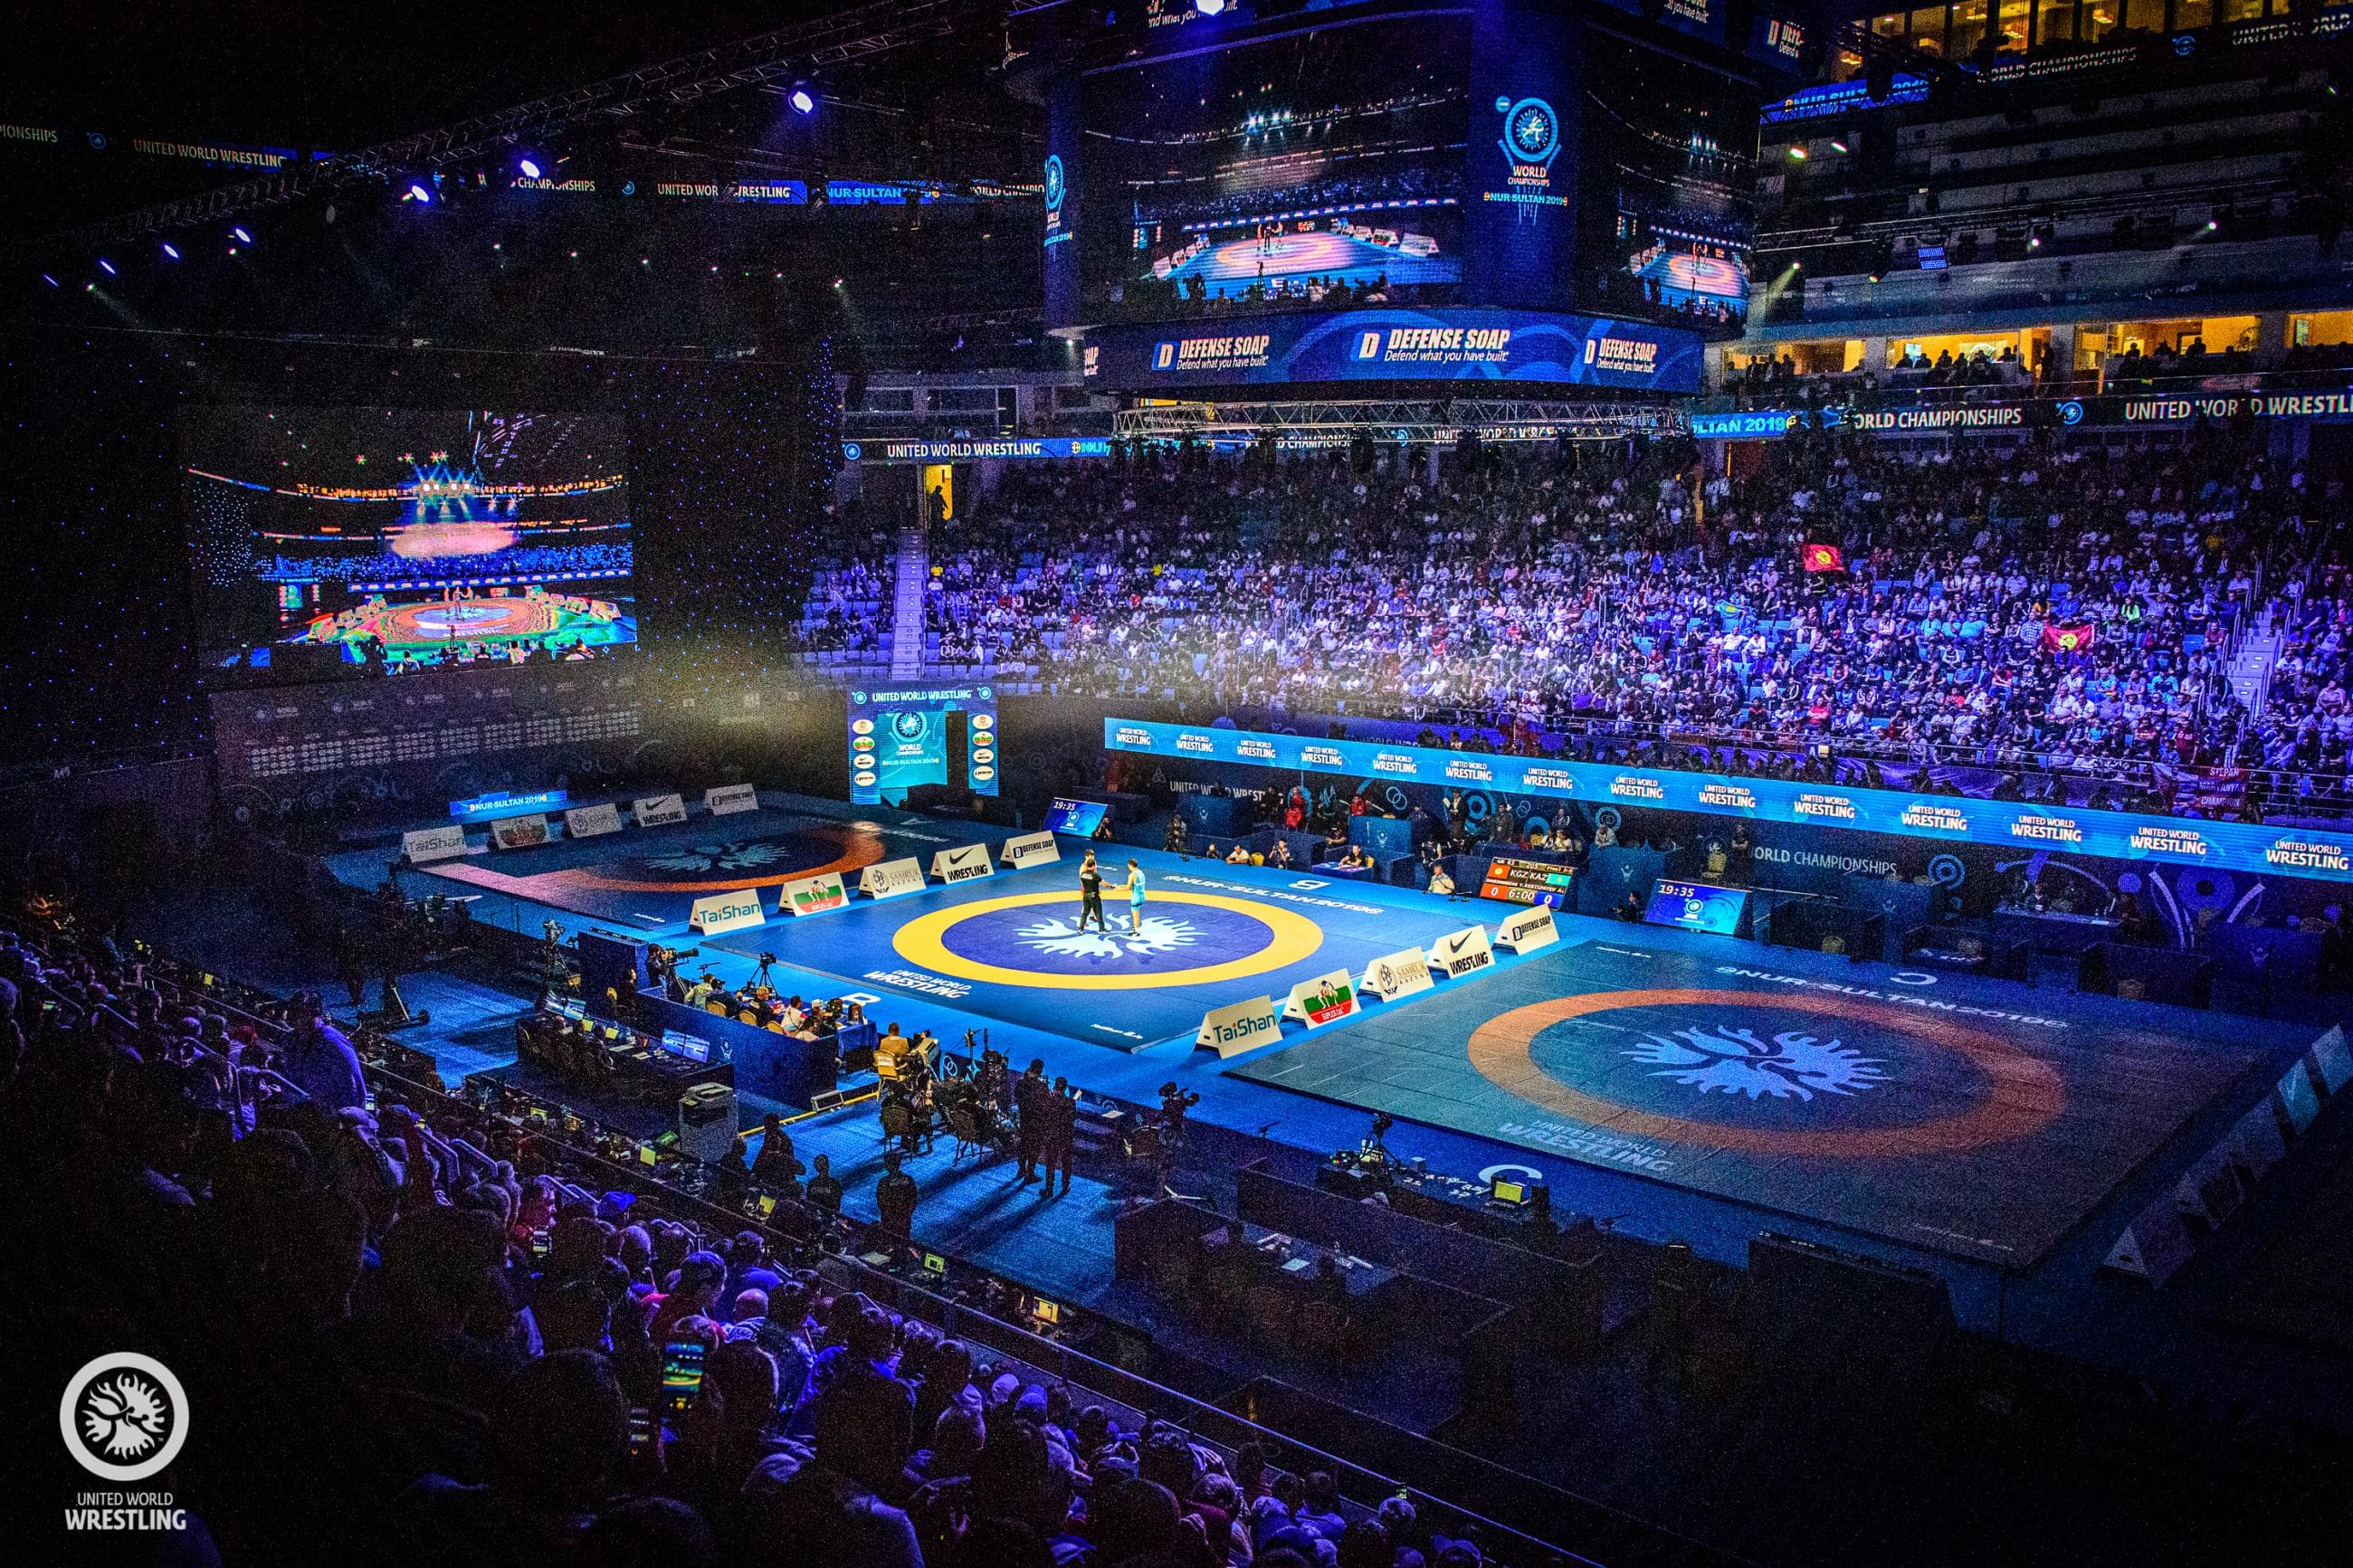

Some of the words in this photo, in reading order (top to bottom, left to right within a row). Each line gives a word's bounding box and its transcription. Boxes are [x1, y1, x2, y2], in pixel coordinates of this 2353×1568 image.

[134, 138, 176, 156] UNITED
[178, 145, 218, 160] WORLD
[1512, 166, 1547, 178] WORLD
[1508, 176, 1550, 187] CHAMPIONSHIPS
[658, 183, 693, 196] UNITED
[695, 184, 719, 197] WOR
[1546, 195, 1564, 206] 2019
[1179, 338, 1234, 359] DEFENSE
[1234, 335, 1270, 356] SOAP
[1359, 333, 1381, 359] D
[1387, 328, 1464, 350] DEFENSE
[1464, 329, 1510, 350] SOAP
[1158, 344, 1174, 368] D
[1385, 350, 1419, 362] Defend
[1419, 350, 1443, 362] what
[1443, 351, 1462, 365] you
[1462, 350, 1484, 362] have
[1585, 339, 1596, 365] D
[1599, 337, 1634, 360] DEFENSE
[1634, 342, 1657, 363] SOAP
[1177, 357, 1201, 371] Defend
[1201, 357, 1218, 369] what
[1217, 358, 1232, 372] you
[1232, 356, 1249, 368] have
[1854, 413, 1894, 429] ORLD
[1898, 407, 2023, 429] CHAMPIONSHIPS
[2126, 401, 2191, 421] UNITED
[1744, 418, 1786, 432] 2019
[888, 443, 929, 458] UNITED
[931, 443, 972, 458] WORLD
[974, 442, 1042, 457] WRESTLING
[872, 691, 899, 703] UNITED
[900, 691, 928, 701] WORLD
[928, 689, 973, 700] WRESTLING
[899, 744, 921, 752] WORLD
[1116, 734, 1151, 746] WRESTLING
[1176, 740, 1214, 753] WRESTLING
[1241, 739, 1254, 747] UNITED
[1254, 740, 1272, 749] WORLD
[1237, 746, 1275, 759] WRESTLING
[1301, 753, 1343, 765] WRESTLING
[1321, 747, 1338, 755] WORLD
[1377, 753, 1394, 761] UNITED
[1395, 755, 1412, 763] WORLD
[1373, 760, 1416, 774] WRESTLING
[1450, 760, 1468, 768] UNITED
[1469, 762, 1487, 770] WORLD
[1528, 767, 1547, 776] UNITED
[1548, 769, 1567, 778] WORLD
[2210, 767, 2240, 777] STEPAN
[1445, 766, 1491, 782] WRESTLING
[1523, 774, 1573, 789] WRESTLING
[1615, 776, 1635, 785] UNITED
[1637, 778, 1658, 787] WORLD
[1610, 783, 1663, 799] WRESTLING
[1705, 784, 1726, 794] UNITED
[1727, 786, 1749, 796] WORLD
[476, 796, 524, 811] NUR-SULTAN
[524, 794, 543, 805] 2019
[1053, 802, 1076, 812] 19:35
[1699, 792, 1756, 808] WRESTLING
[1800, 794, 1824, 804] UNITED
[1825, 795, 1849, 805] WORLD
[1794, 802, 1854, 819] WRESTLING
[1909, 805, 1934, 815] UNITED
[1935, 807, 1960, 817] WORLD
[1901, 813, 1967, 831] WRESTLING
[2019, 815, 2046, 827] UNITED
[2047, 818, 2075, 829] WORLD
[2012, 824, 2082, 842] WRESTLING
[2139, 827, 2167, 839] UNITED
[2169, 830, 2199, 841] WORLD
[1023, 841, 1042, 852] DEFENSE
[1042, 840, 1054, 848] SOAP
[2130, 836, 2206, 855] WRESTLING
[2275, 841, 2307, 851] UNITED
[2309, 844, 2341, 855] WORLD
[1755, 846, 1791, 863] ORLD
[1795, 851, 1898, 876] CHAMPIONSHIPS
[2265, 850, 2349, 870] WRESTLING
[890, 866, 921, 880] SAMRUK
[948, 864, 988, 881] WRESTLING
[1510, 870, 1529, 878] KGZ
[1529, 871, 1548, 881] KAZ
[1175, 877, 1315, 905] NUR-SULTAN
[1315, 898, 1371, 913] 2019
[1491, 887, 1499, 896] 0
[1509, 889, 1535, 900] 6:00
[1544, 895, 1553, 904] 0
[1658, 884, 1695, 898] 19:35
[700, 902, 761, 925] TaiShan
[1520, 920, 1538, 934] DEFENSE
[1538, 916, 1551, 927] SOAP
[1396, 961, 1428, 977] SAMRUK
[1449, 951, 1489, 975] WRESTLING
[862, 970, 970, 999] WRESTLING
[892, 970, 933, 981] UNITED
[929, 978, 972, 990] WORLD
[1736, 969, 1958, 1012] NUR-SULTAN
[1213, 1013, 1277, 1043] TaiShan
[1534, 1120, 1596, 1141] UNITED
[1593, 1136, 1667, 1157] WORLD
[1498, 1123, 1673, 1172] WRESTLING
[1478, 1164, 1542, 1185] C
